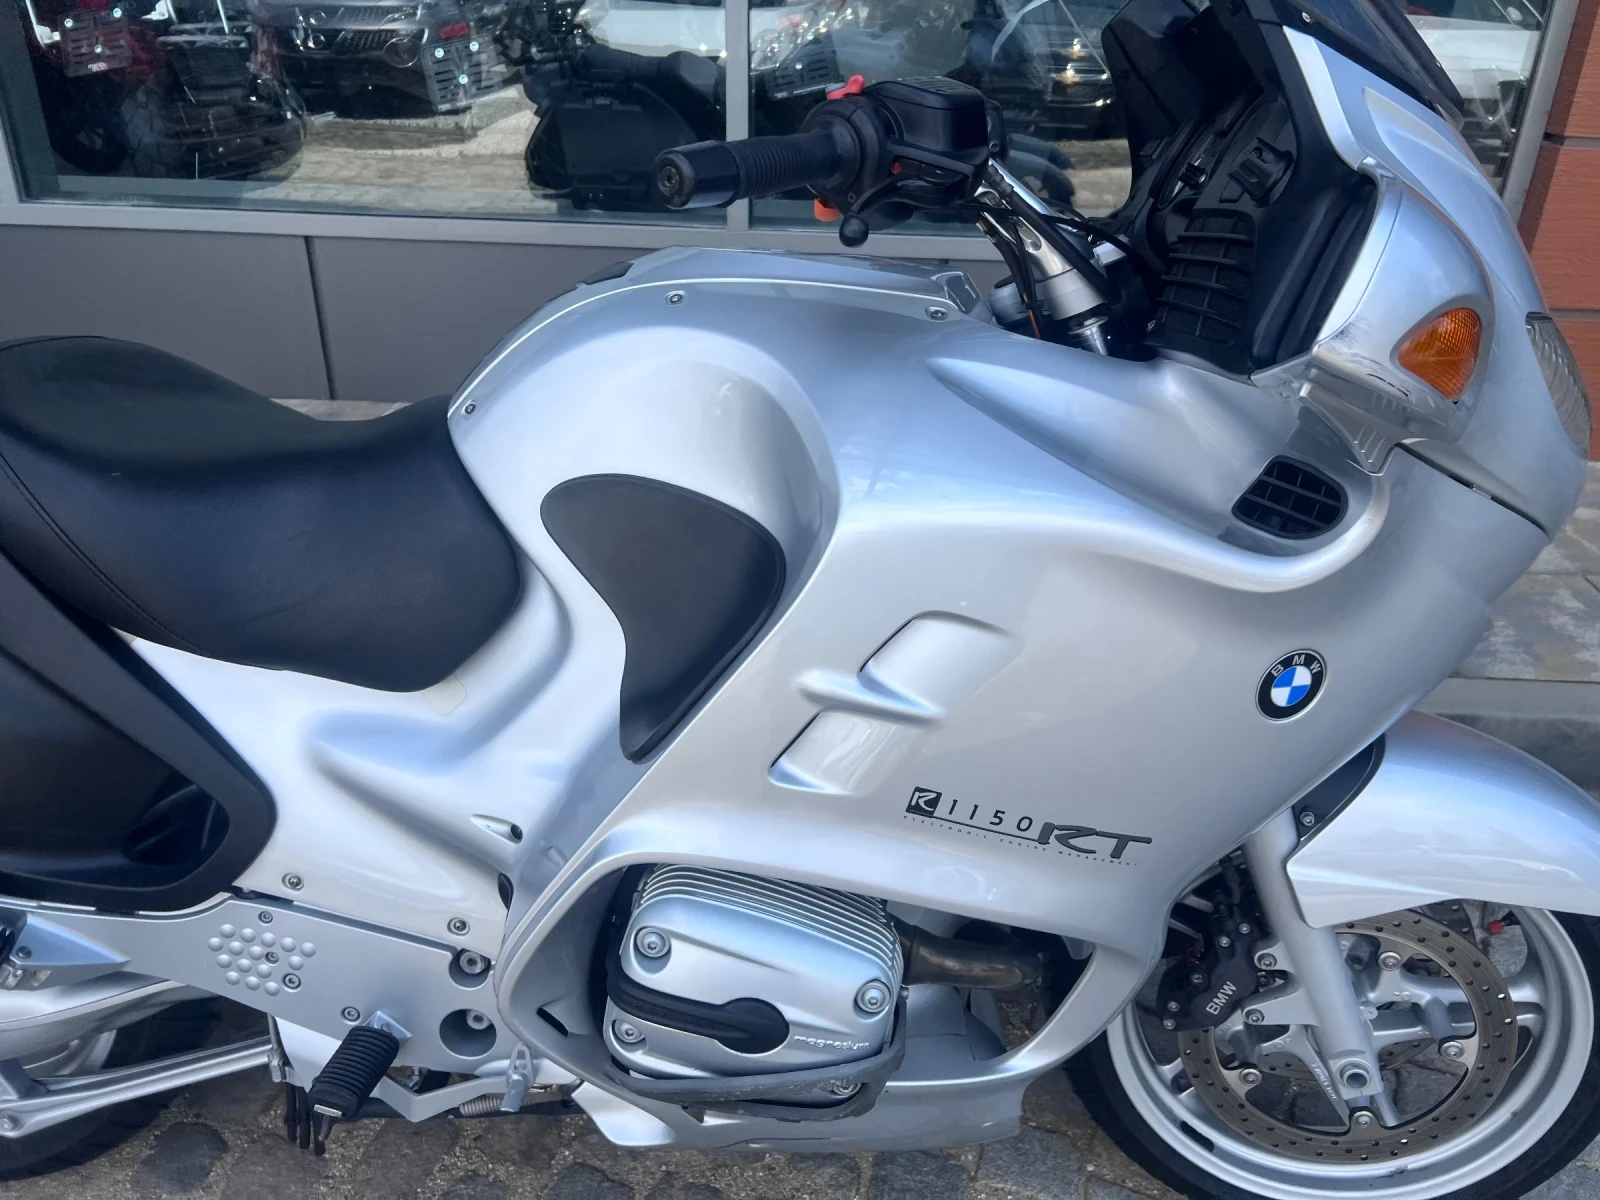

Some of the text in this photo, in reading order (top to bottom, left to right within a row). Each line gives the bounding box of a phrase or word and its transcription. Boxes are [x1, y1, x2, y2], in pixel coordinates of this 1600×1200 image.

[1270, 654, 1321, 677] BMW
[903, 815, 988, 839] ELECTRONIC
[1000, 838, 1047, 852] ENGINE
[1037, 822, 1153, 859] RT
[1205, 981, 1237, 1015] BMW
[794, 1035, 870, 1050] magnesium
